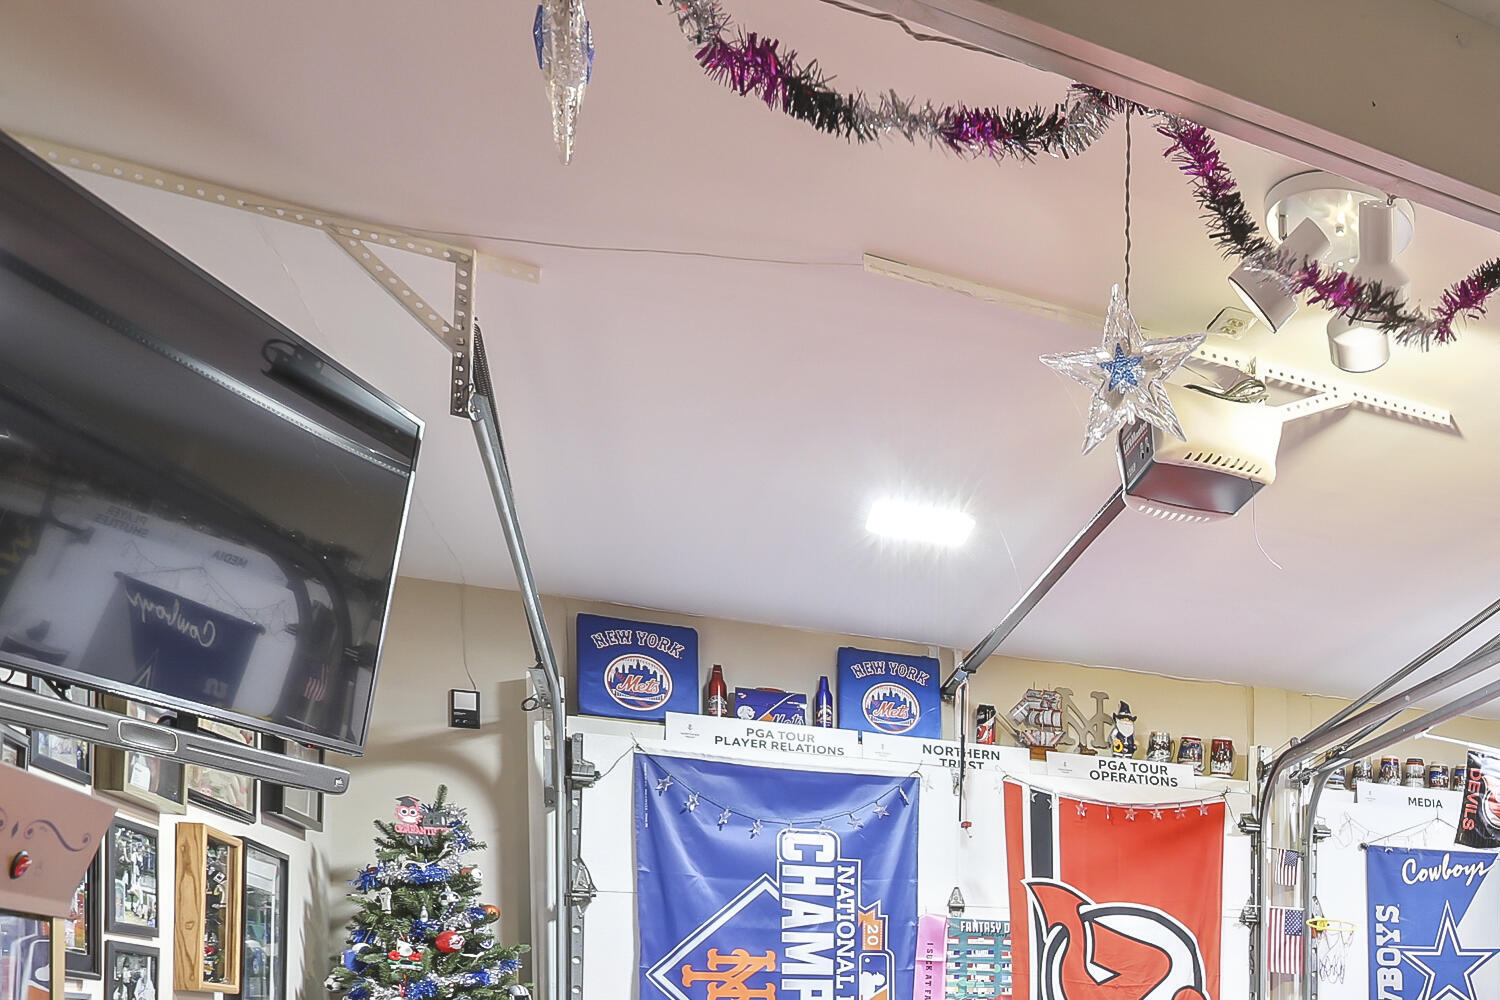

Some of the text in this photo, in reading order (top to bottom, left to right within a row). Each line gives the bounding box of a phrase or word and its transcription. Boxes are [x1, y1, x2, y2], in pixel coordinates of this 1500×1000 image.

[591, 630, 685, 659] NEW YORK
[851, 661, 930, 686] NEW YORK
[616, 674, 660, 694] Mets
[872, 701, 909, 719] Mets
[746, 728, 815, 743] PGA TOUR
[714, 736, 845, 756] PLAYER RELATIONS
[922, 744, 1000, 760] NORTHERN
[1098, 760, 1168, 775] PGA TOUR
[1089, 770, 1178, 787] OPERATIONS
[1408, 797, 1443, 808] MEDIA
[1462, 768, 1482, 831] DEVILS
[1402, 853, 1493, 886] Cowboys
[836, 865, 856, 990] NATIONAL
[867, 925, 879, 945] 20
[960, 921, 1002, 933] FANTASY
[925, 974, 932, 987] AT
